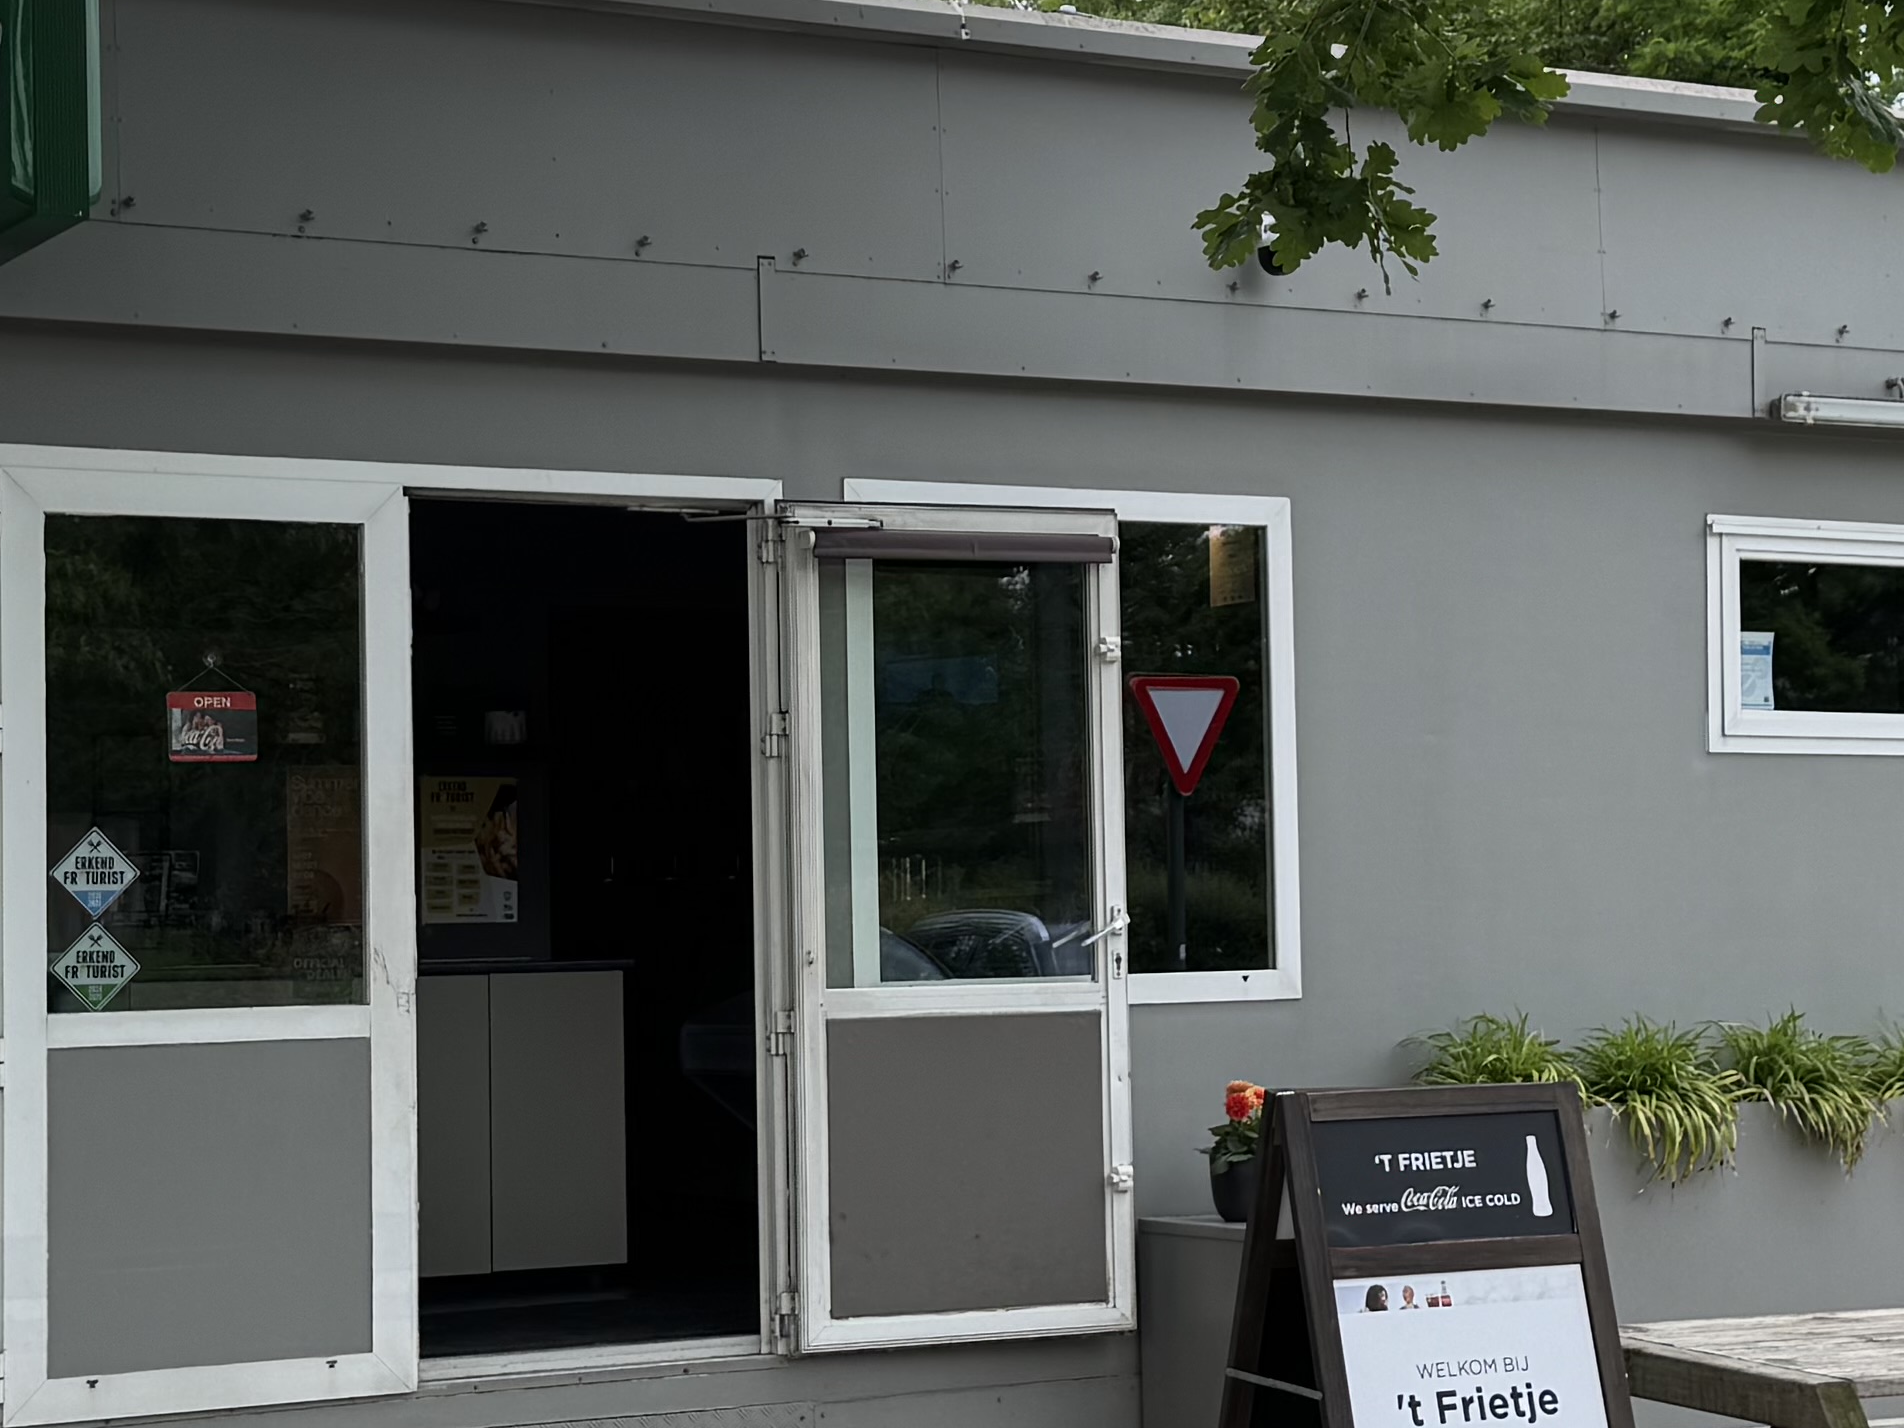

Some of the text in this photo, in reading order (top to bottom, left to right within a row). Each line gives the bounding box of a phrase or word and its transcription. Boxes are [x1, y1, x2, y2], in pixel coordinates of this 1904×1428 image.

[193, 696, 232, 709] OPEN
[75, 855, 115, 870] ERKEND
[76, 950, 116, 964] ERKEND
[1397, 1149, 1477, 1172] FRIETJE
[1342, 1202, 1363, 1216] We
[1366, 1201, 1399, 1214] serve
[1461, 1194, 1484, 1209] ICE
[1485, 1193, 1522, 1207] COLD
[1415, 1355, 1530, 1379] WELKOM BIJ
[1397, 1381, 1560, 1427] 't Frietje
